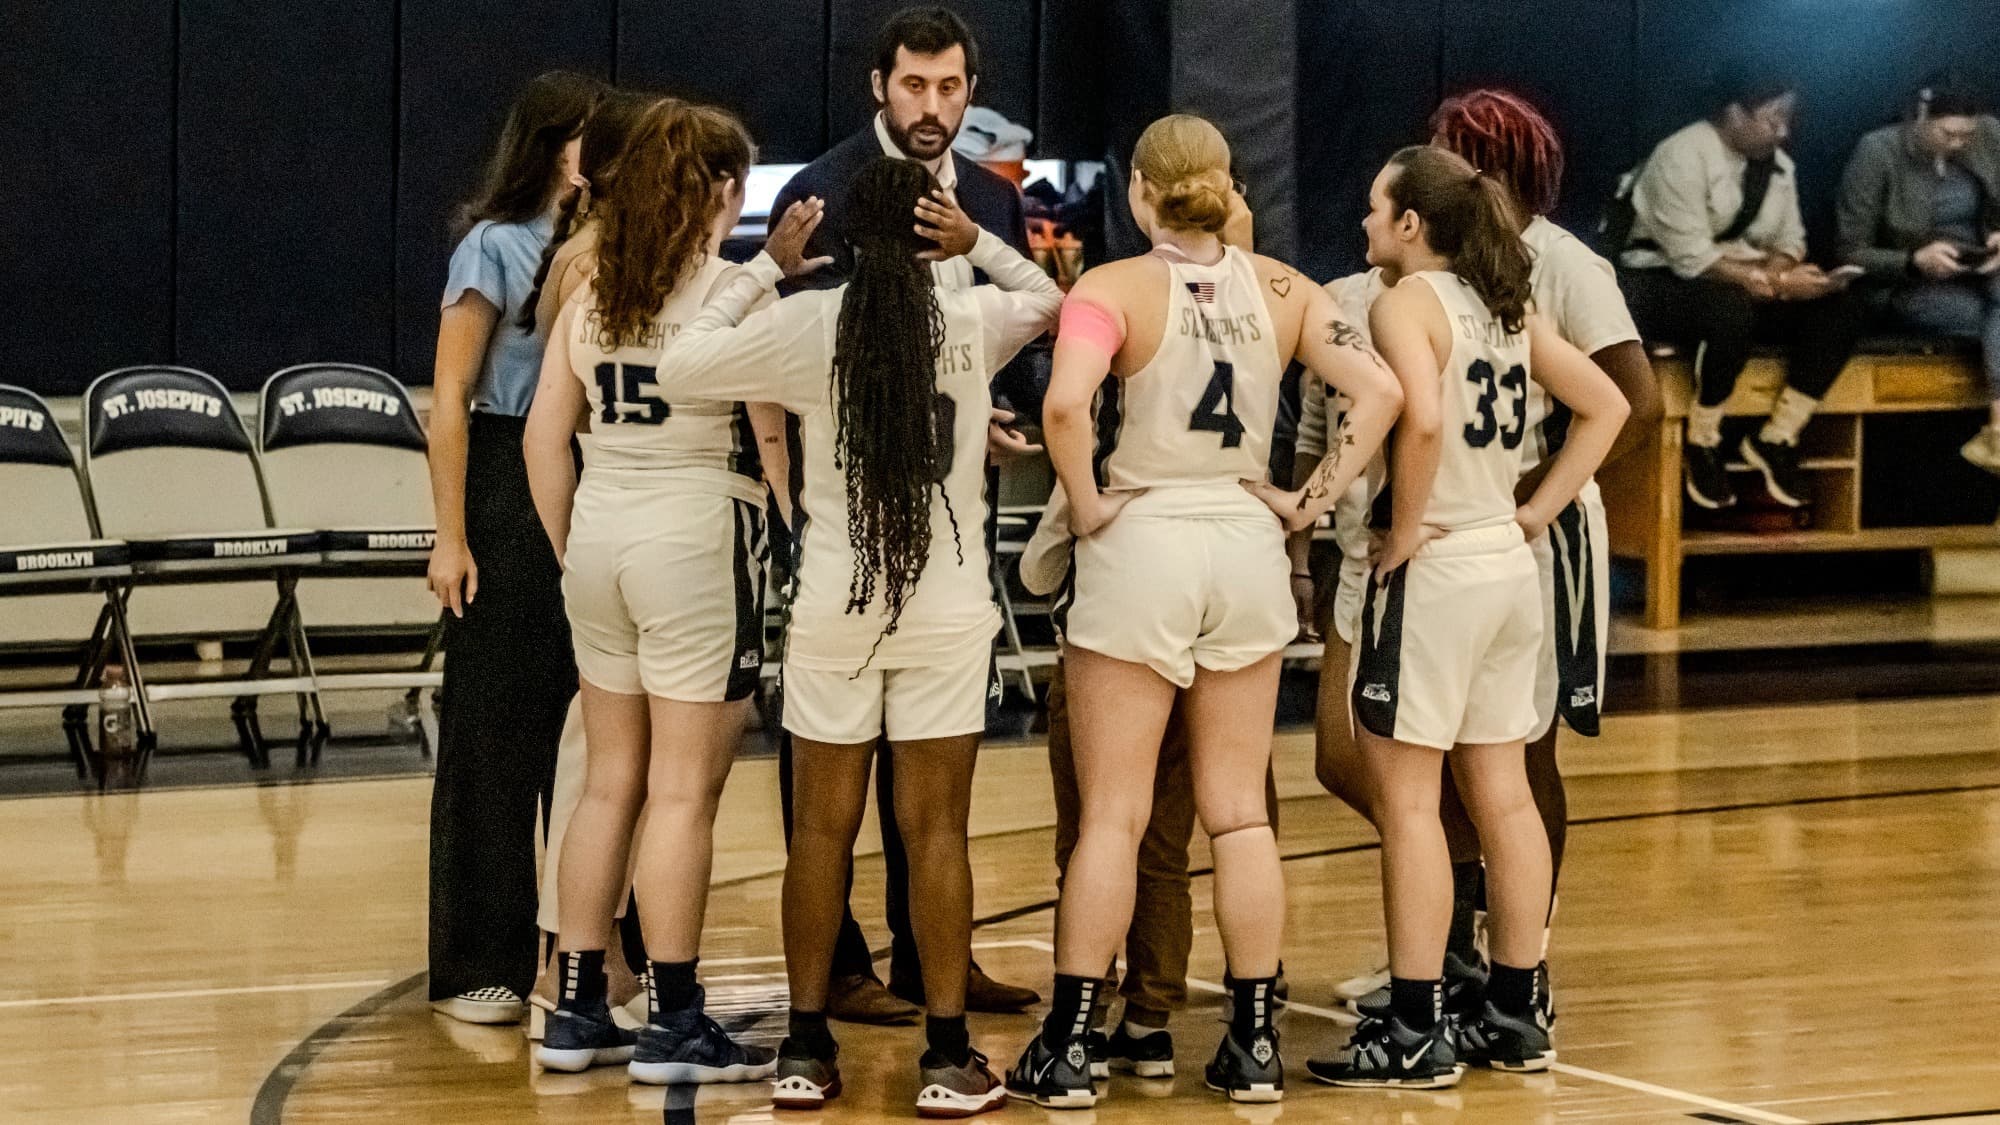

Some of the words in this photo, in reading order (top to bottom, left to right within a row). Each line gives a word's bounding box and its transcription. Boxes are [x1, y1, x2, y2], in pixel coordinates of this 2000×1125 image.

[102, 394, 135, 419] ST.
[135, 388, 222, 418] JOSEPH'S
[279, 391, 312, 416] ST.
[312, 387, 399, 416] JOSEPH'S
[594, 361, 671, 426] 15
[1188, 360, 1247, 448] 4
[1462, 358, 1528, 450] 33
[0, 406, 44, 431] PH'S
[213, 539, 288, 557] BROOKLYN
[368, 533, 437, 549] BROOKLY
[16, 551, 94, 571] BROOKLYN
